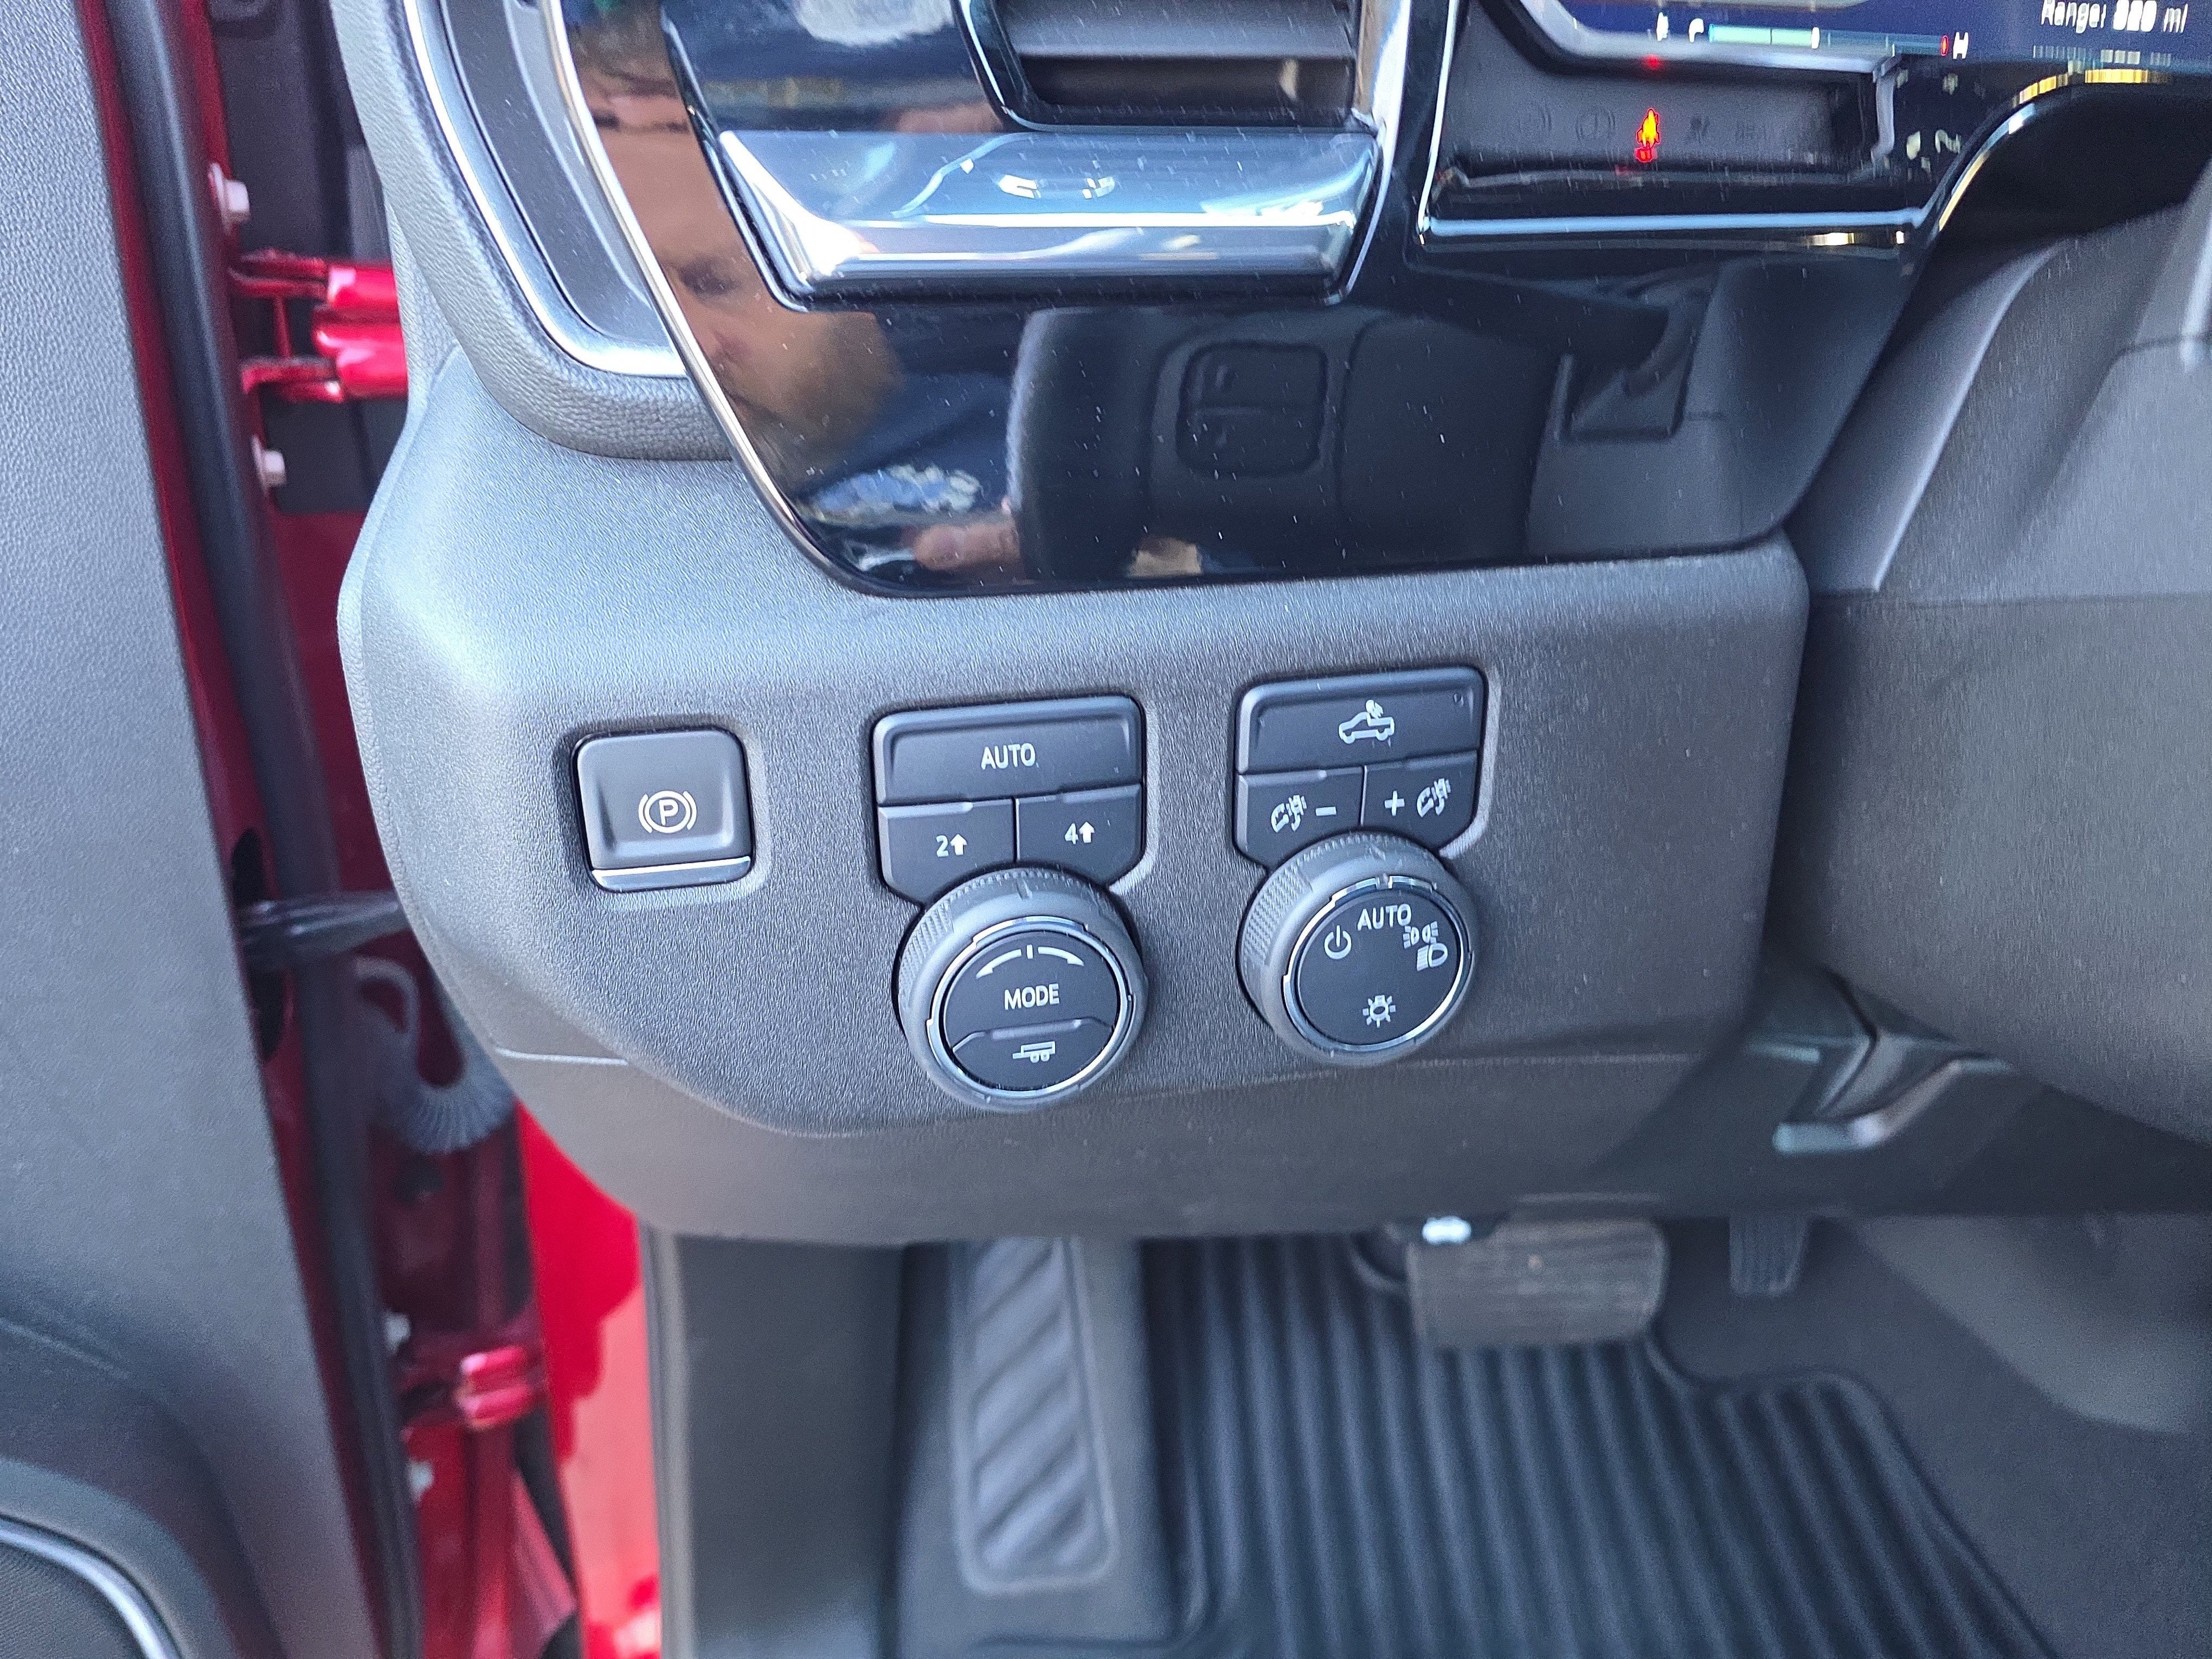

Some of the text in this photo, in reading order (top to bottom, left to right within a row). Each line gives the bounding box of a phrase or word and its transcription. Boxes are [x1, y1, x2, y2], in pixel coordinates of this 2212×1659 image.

[2163, 3, 2189, 33] mi
[1952, 32, 1969, 59] H
[981, 742, 1036, 770] AUTO
[659, 799, 679, 826] P
[1357, 903, 1412, 931] AUTO
[1004, 983, 1060, 1010] MODE
